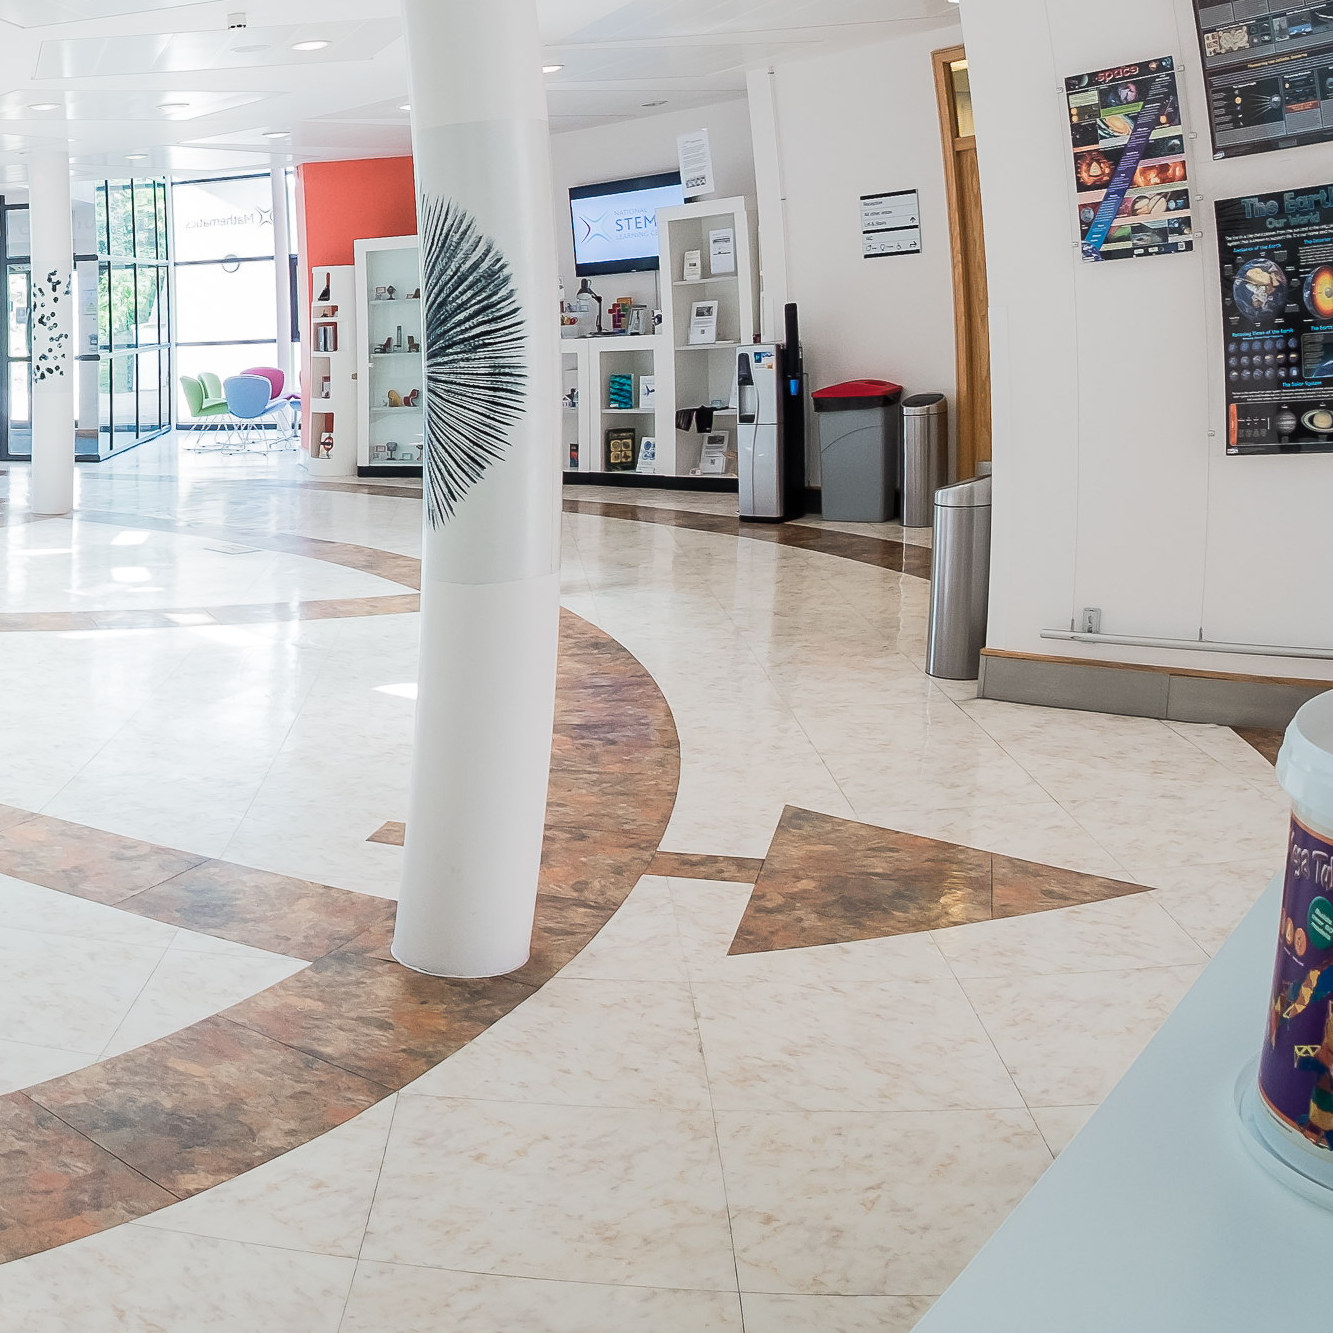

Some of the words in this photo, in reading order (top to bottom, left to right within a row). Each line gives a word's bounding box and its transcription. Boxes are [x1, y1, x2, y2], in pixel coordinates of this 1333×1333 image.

[1096, 66, 1139, 83] space
[614, 207, 648, 216] NATIONAL
[1241, 197, 1279, 218] The
[615, 215, 656, 232] STEM
[1265, 218, 1287, 229] Our
[1287, 211, 1320, 226] World
[615, 230, 649, 241] LEARNING
